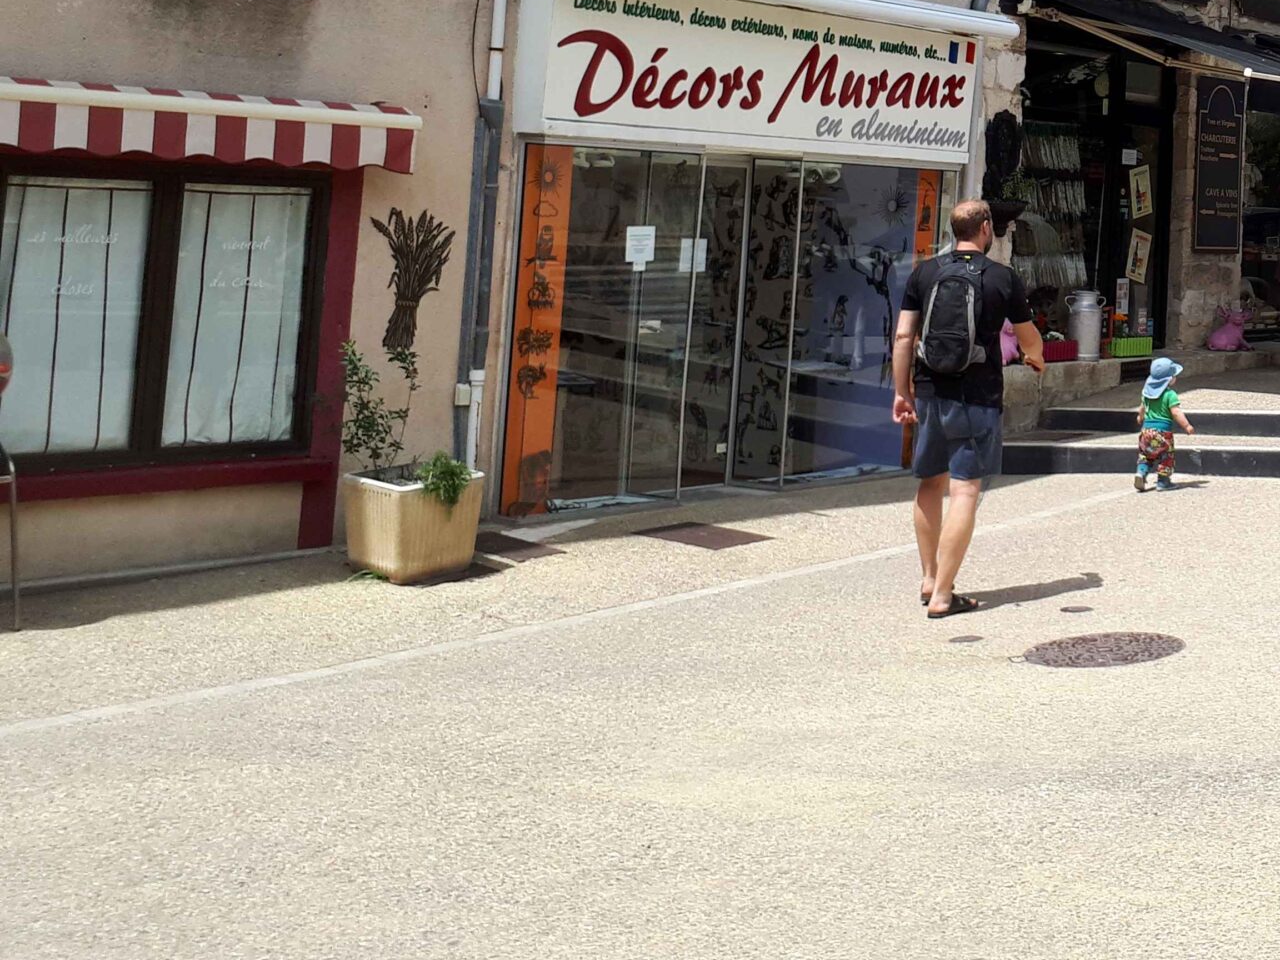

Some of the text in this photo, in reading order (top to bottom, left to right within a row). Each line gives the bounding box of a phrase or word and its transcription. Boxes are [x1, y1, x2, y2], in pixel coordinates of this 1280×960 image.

[623, 0, 685, 26] intérieurs,
[690, 7, 727, 30] décors
[731, 15, 788, 40] extérieurs,
[792, 27, 818, 43] noms
[823, 27, 836, 45] de
[838, 33, 876, 53] maison,
[879, 40, 920, 59] numéros,
[557, 29, 966, 124] Décors Muraux
[816, 109, 966, 149] en aluminium
[1201, 132, 1237, 145] CHARCUTERIE
